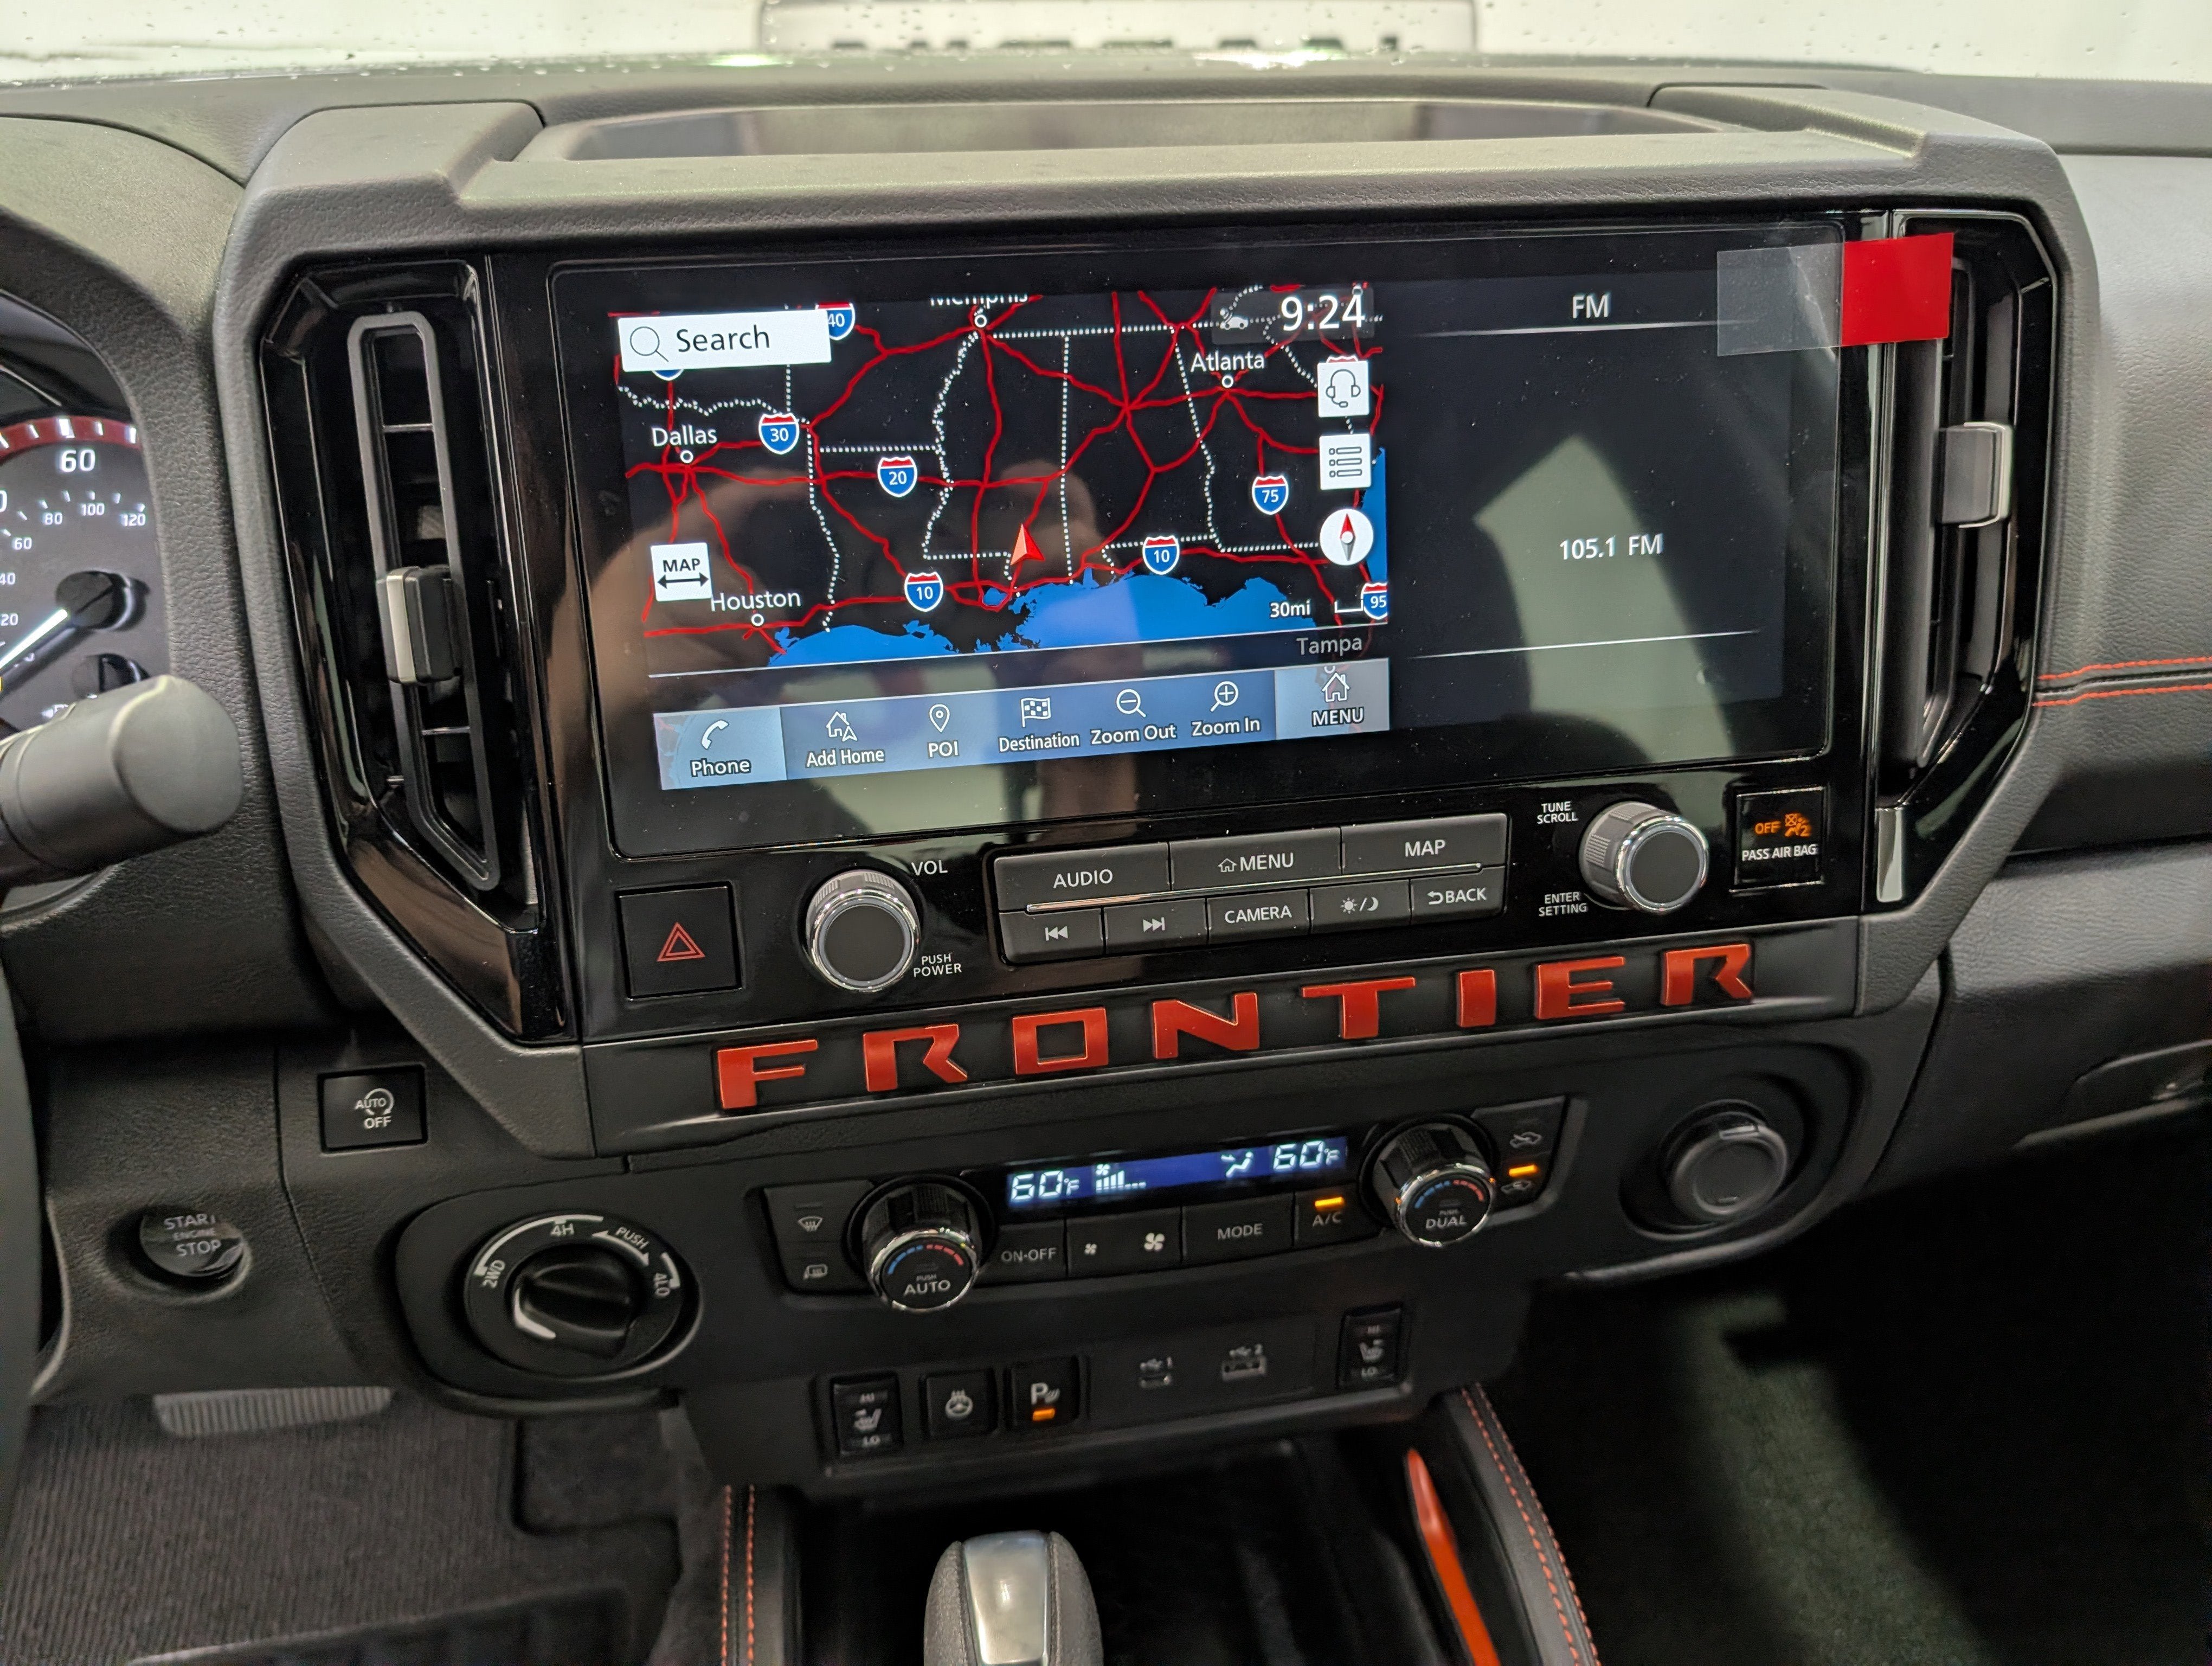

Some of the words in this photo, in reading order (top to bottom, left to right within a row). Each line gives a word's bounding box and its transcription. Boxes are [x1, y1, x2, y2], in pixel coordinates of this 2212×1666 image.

[1281, 295, 1365, 332] 9:24
[1572, 293, 1611, 319] FM
[828, 313, 845, 328] 40
[677, 324, 770, 354] Search
[1191, 351, 1265, 373] Atlanta
[652, 425, 717, 447] Dallas
[770, 428, 789, 443] 30
[61, 449, 95, 473] 60
[889, 471, 907, 486] 20
[1262, 489, 1279, 504] 75
[81, 503, 105, 516] 100
[43, 512, 63, 525] 80
[121, 512, 146, 527] 120
[13, 536, 32, 550] 60
[1559, 536, 1616, 561] 105.1
[1628, 533, 1664, 556] FM
[1154, 549, 1170, 564] 10
[663, 558, 701, 573] MAP
[0, 572, 16, 586] 40
[917, 586, 934, 600] 10
[710, 590, 801, 613] Houston
[1270, 599, 1311, 618] 30mi
[1370, 595, 1386, 608] 95
[1, 613, 19, 626] 20
[1296, 636, 1362, 656] Tampa
[1312, 708, 1364, 727] MENU
[1091, 728, 1140, 745] Zoom
[1143, 725, 1176, 741] Out
[1192, 720, 1240, 737] Zoom
[1244, 717, 1261, 733] In
[928, 741, 960, 758] POI
[998, 733, 1080, 753] Destination
[806, 751, 837, 768] Add
[840, 748, 885, 766] Home
[691, 759, 751, 777] Phone
[1541, 801, 1571, 813] TUNE
[1536, 812, 1578, 824] SCROLL
[1755, 821, 1781, 835] OFF
[1405, 839, 1446, 858] MAP
[1742, 848, 1770, 861] PASS
[1771, 846, 1792, 858] AIR
[1793, 843, 1818, 857] BAG
[911, 860, 948, 876] VOL
[1239, 853, 1295, 872] MENU
[1053, 869, 1113, 889] AUDIO
[1445, 888, 1487, 904] BACK
[1544, 892, 1580, 905] ENTER
[1224, 904, 1293, 925] CAMERA
[1538, 903, 1587, 917] SETTING
[921, 952, 951, 965] PUSH
[913, 963, 962, 977] POWER
[715, 943, 1754, 1110] FRONTIER
[355, 1098, 387, 1111] AUTO
[364, 1116, 391, 1129] OFF
[1313, 1211, 1342, 1227] A/C
[1425, 1214, 1467, 1230] DUAL
[550, 1223, 575, 1236] 4H
[616, 1226, 650, 1249] PUSH
[1218, 1222, 1264, 1240] MODE
[176, 1239, 222, 1257] STOP
[483, 1260, 505, 1289] 2WD
[903, 1279, 951, 1296] AUTO
